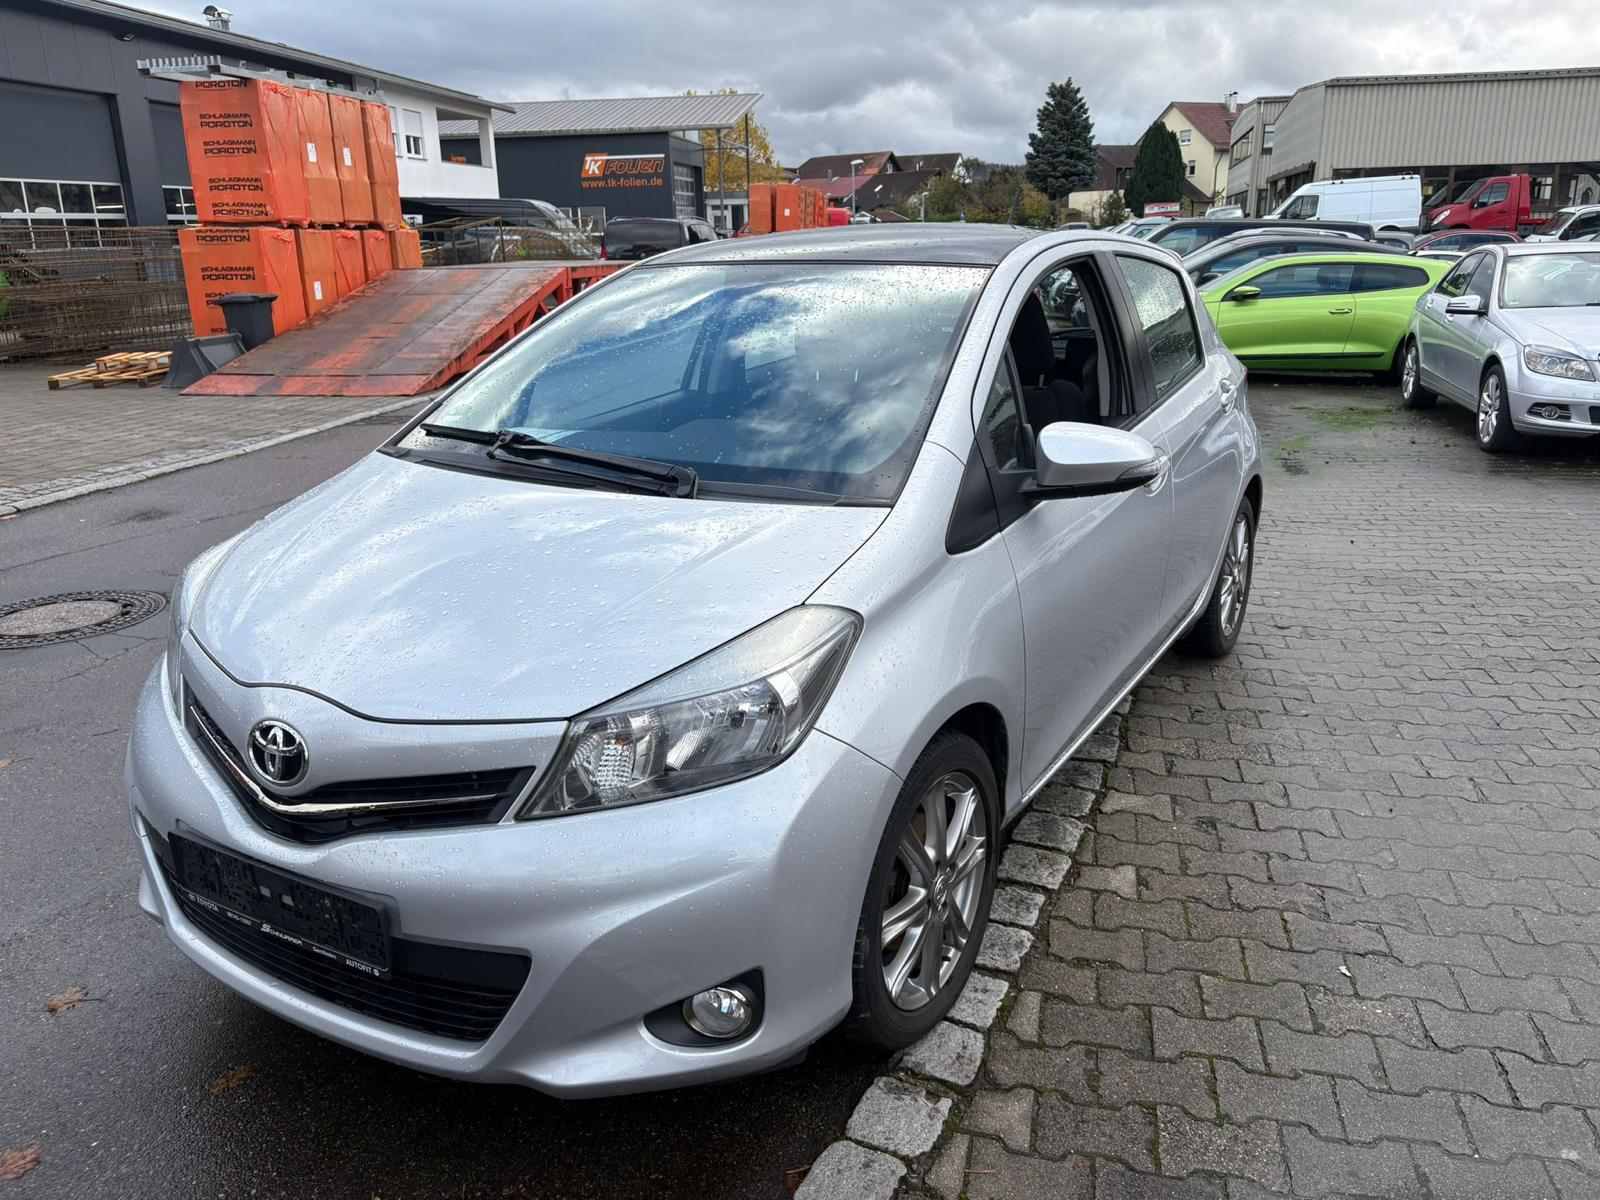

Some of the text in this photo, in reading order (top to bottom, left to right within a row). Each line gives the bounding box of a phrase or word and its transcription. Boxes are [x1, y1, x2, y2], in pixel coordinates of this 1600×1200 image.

[200, 120, 253, 129] POROTON
[204, 146, 257, 154] POROTON
[581, 177, 663, 188] www.tk-folien.de
[209, 183, 264, 192] POROTON
[213, 208, 268, 216] POROTON
[196, 234, 250, 242] POROTON
[202, 273, 256, 281] POROTON
